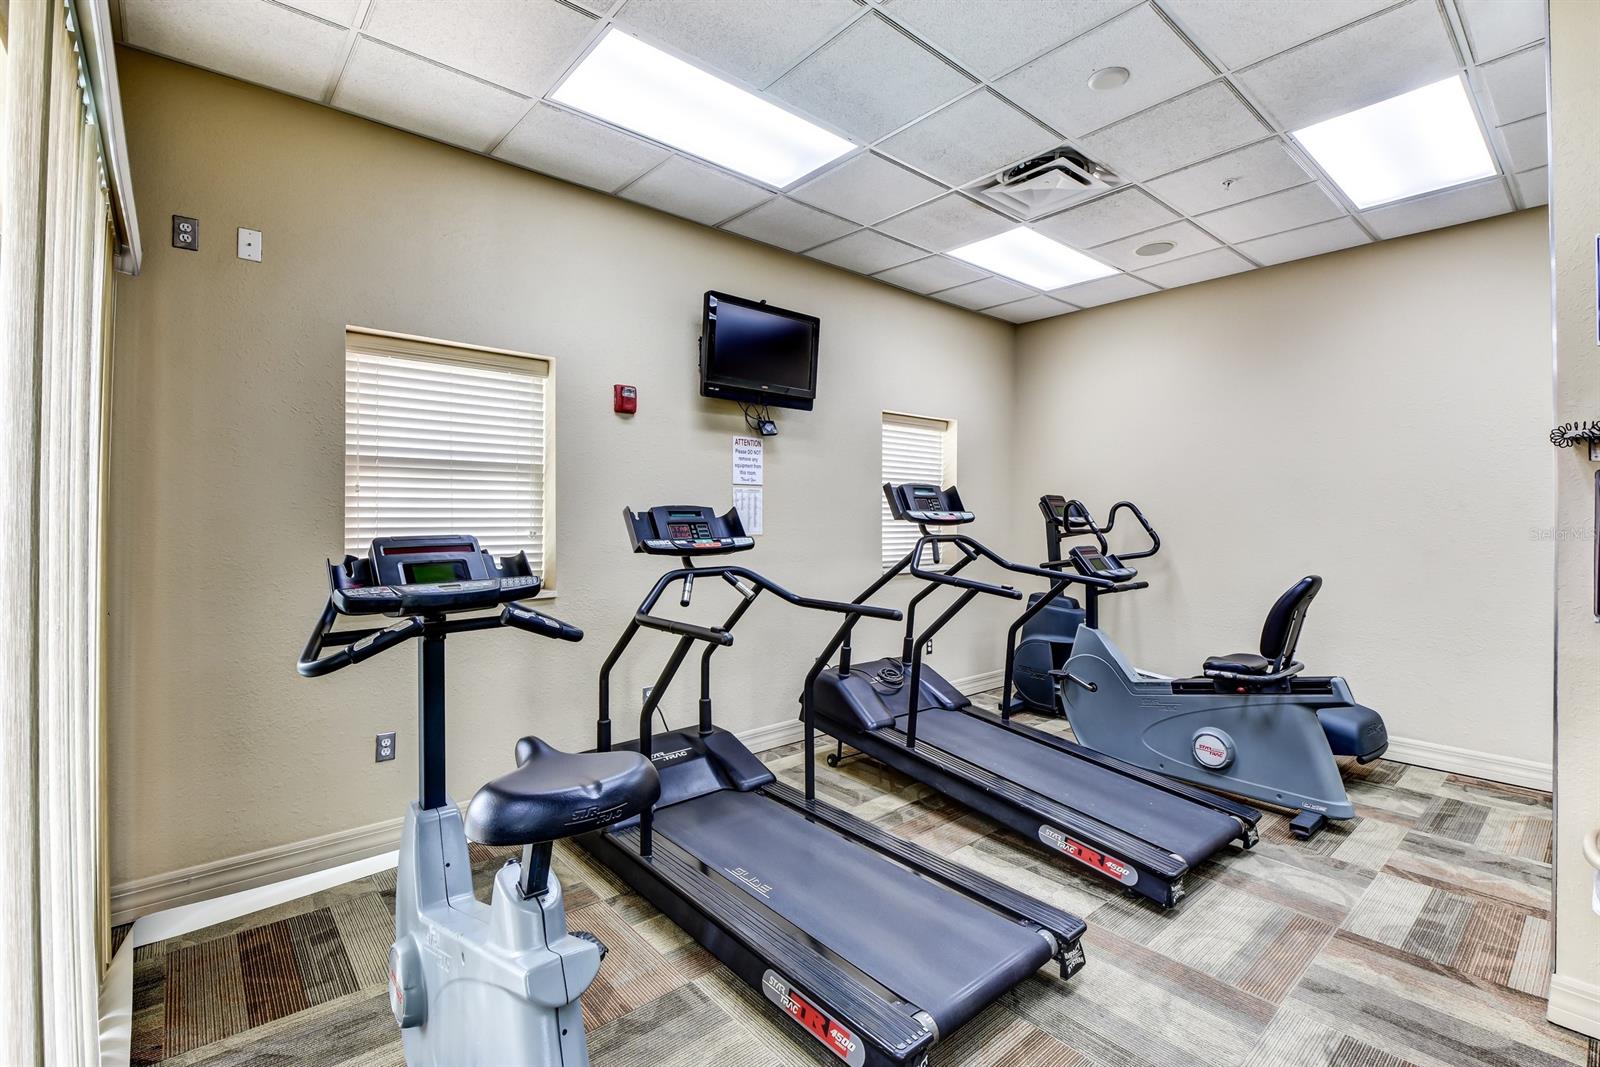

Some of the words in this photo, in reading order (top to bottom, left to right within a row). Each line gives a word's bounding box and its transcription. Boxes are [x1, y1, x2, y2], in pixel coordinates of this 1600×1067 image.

[735, 438, 762, 447] ATTENTION
[1045, 829, 1062, 841] STAR
[1057, 840, 1076, 854] TRAC
[1105, 861, 1130, 876] 4500
[769, 976, 788, 995] STAR
[780, 994, 799, 1014] TRAC
[830, 1028, 857, 1052] 4500
